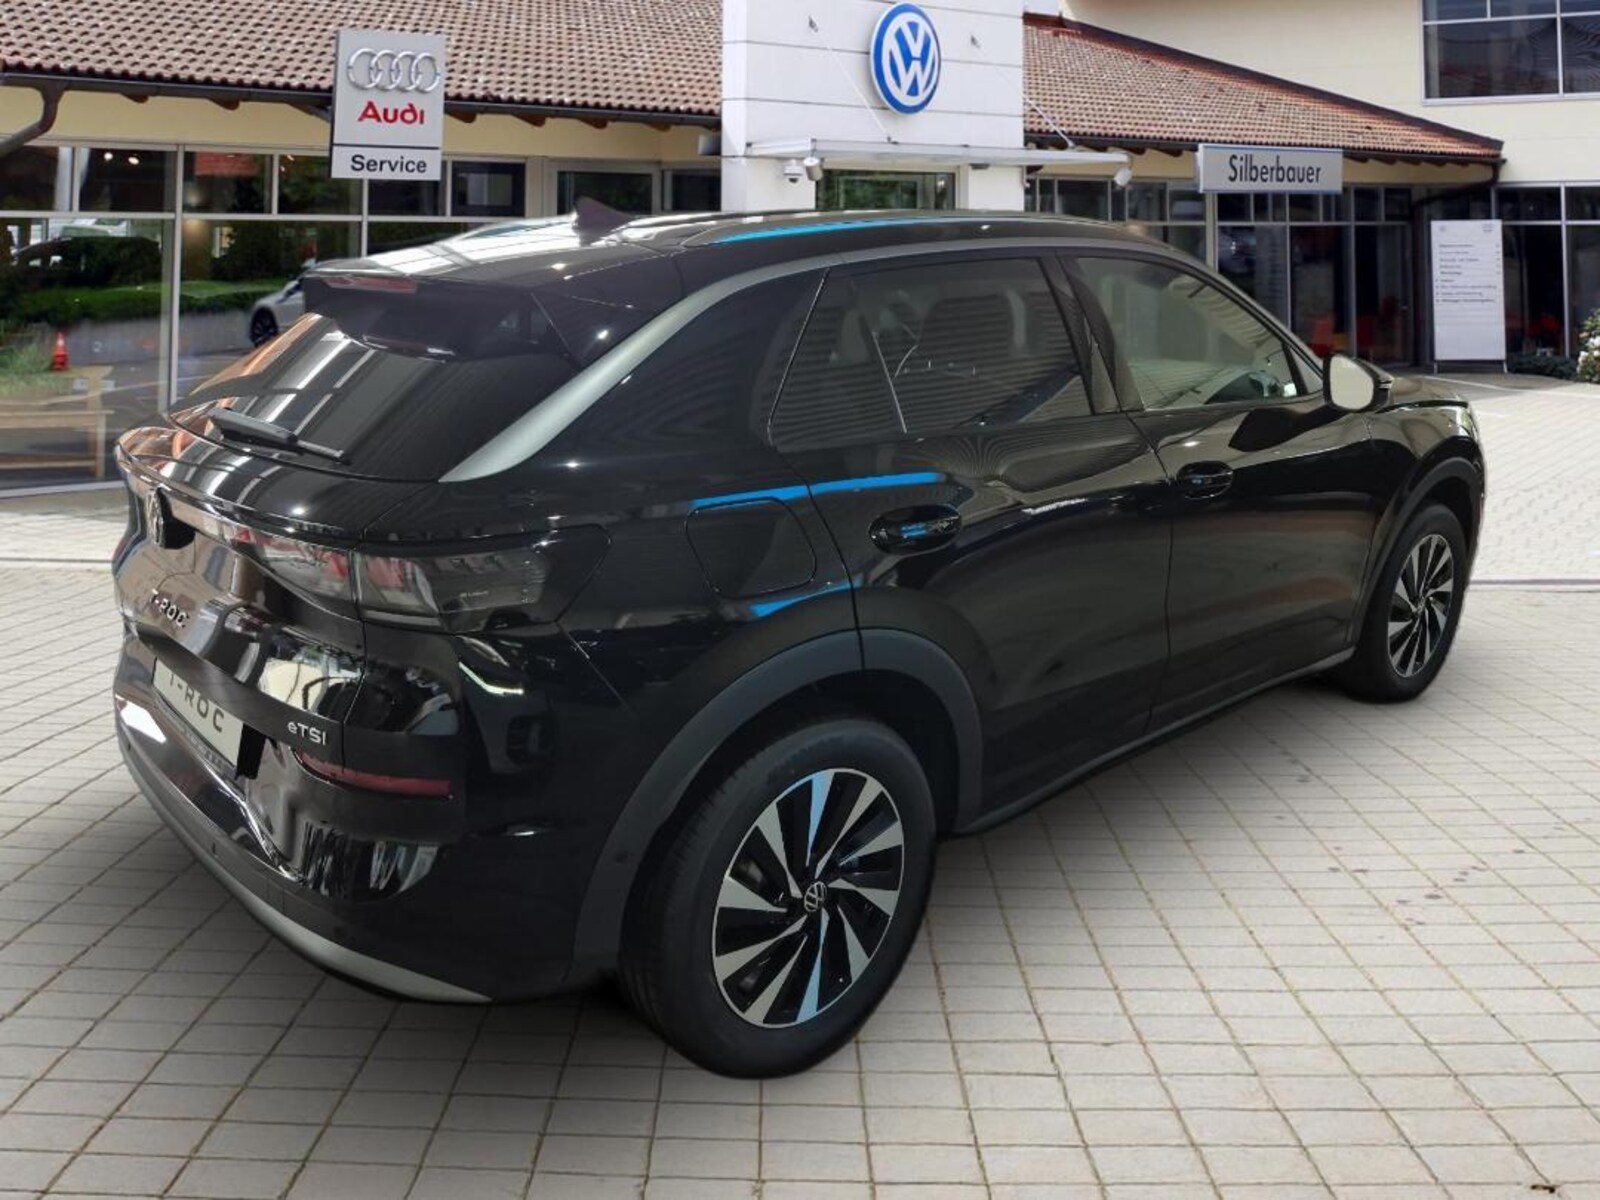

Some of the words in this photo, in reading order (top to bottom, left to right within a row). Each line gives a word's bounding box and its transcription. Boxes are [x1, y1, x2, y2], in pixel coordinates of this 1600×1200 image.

[358, 100, 425, 125] Audi
[351, 154, 428, 173] Service
[1228, 153, 1321, 183] Silberbauer
[287, 721, 327, 746] eTSI
